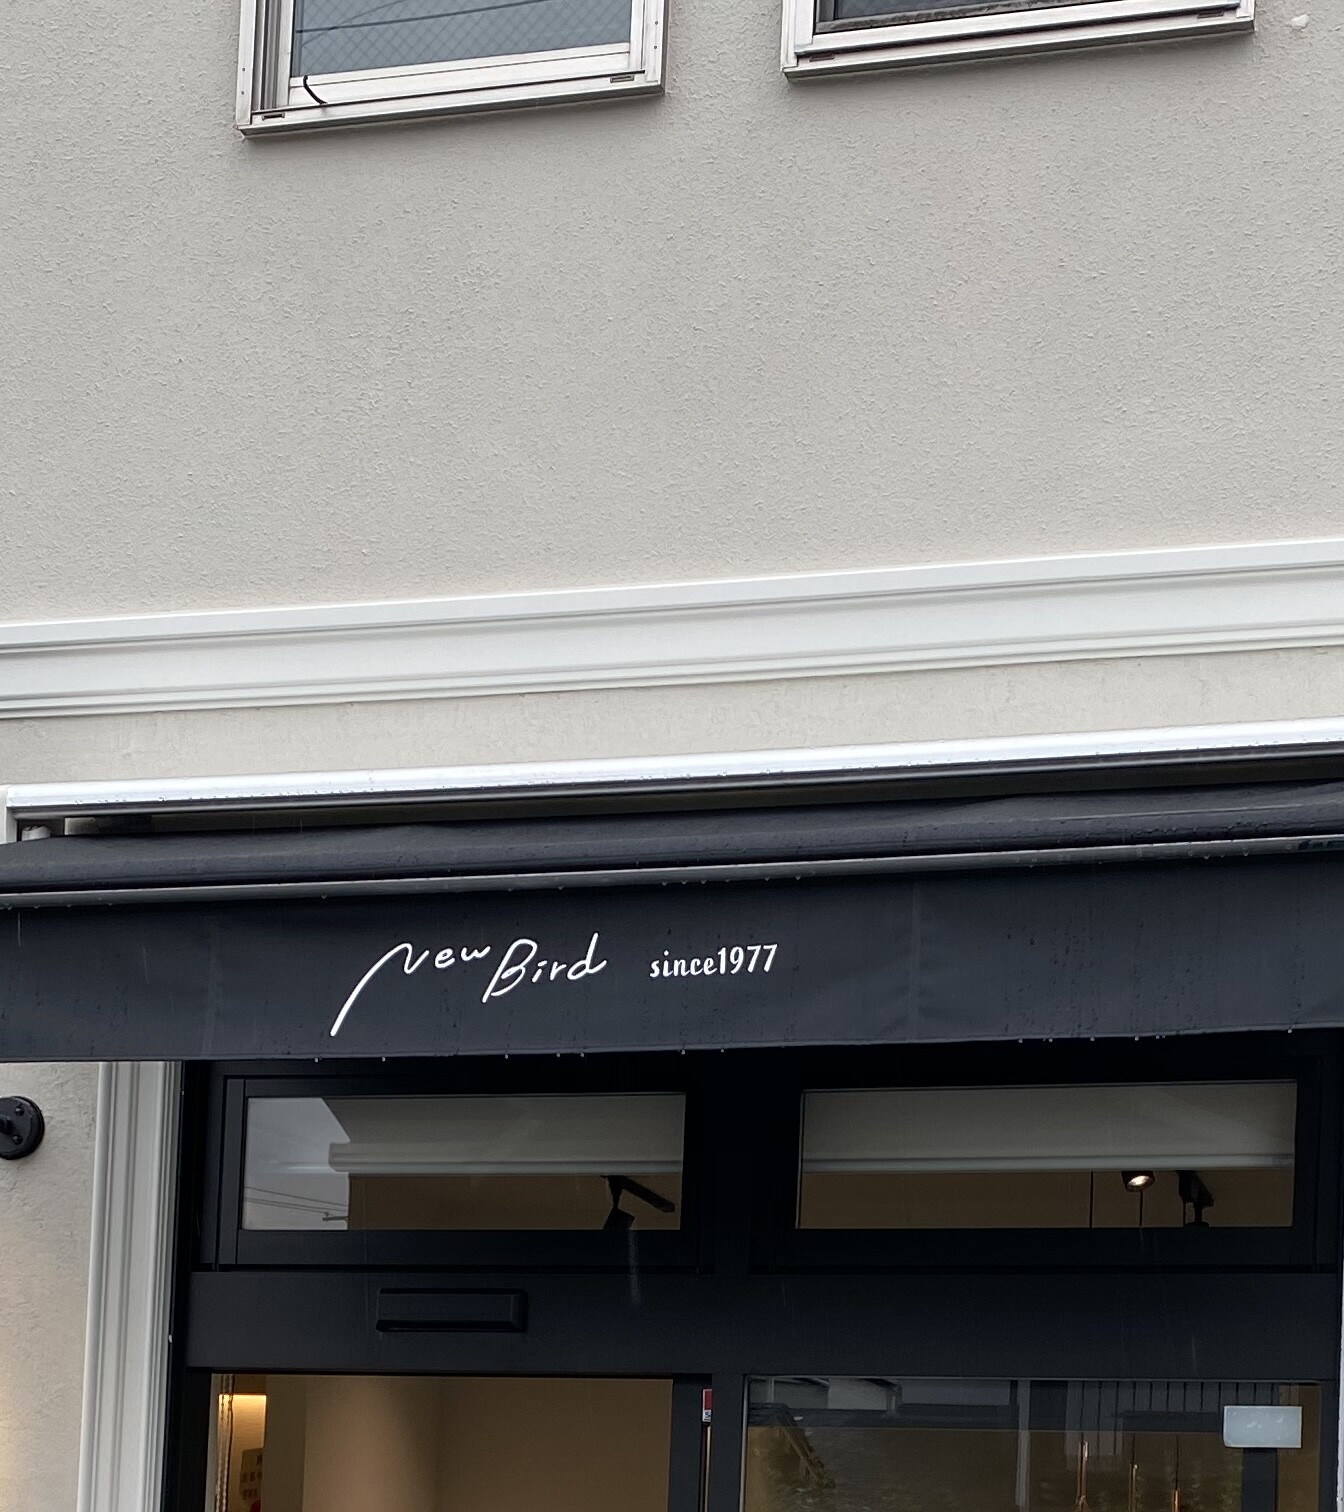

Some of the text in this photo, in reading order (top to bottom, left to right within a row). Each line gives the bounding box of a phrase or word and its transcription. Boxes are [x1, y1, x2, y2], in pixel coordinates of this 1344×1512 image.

[330, 932, 779, 1037] New Bird since1977
